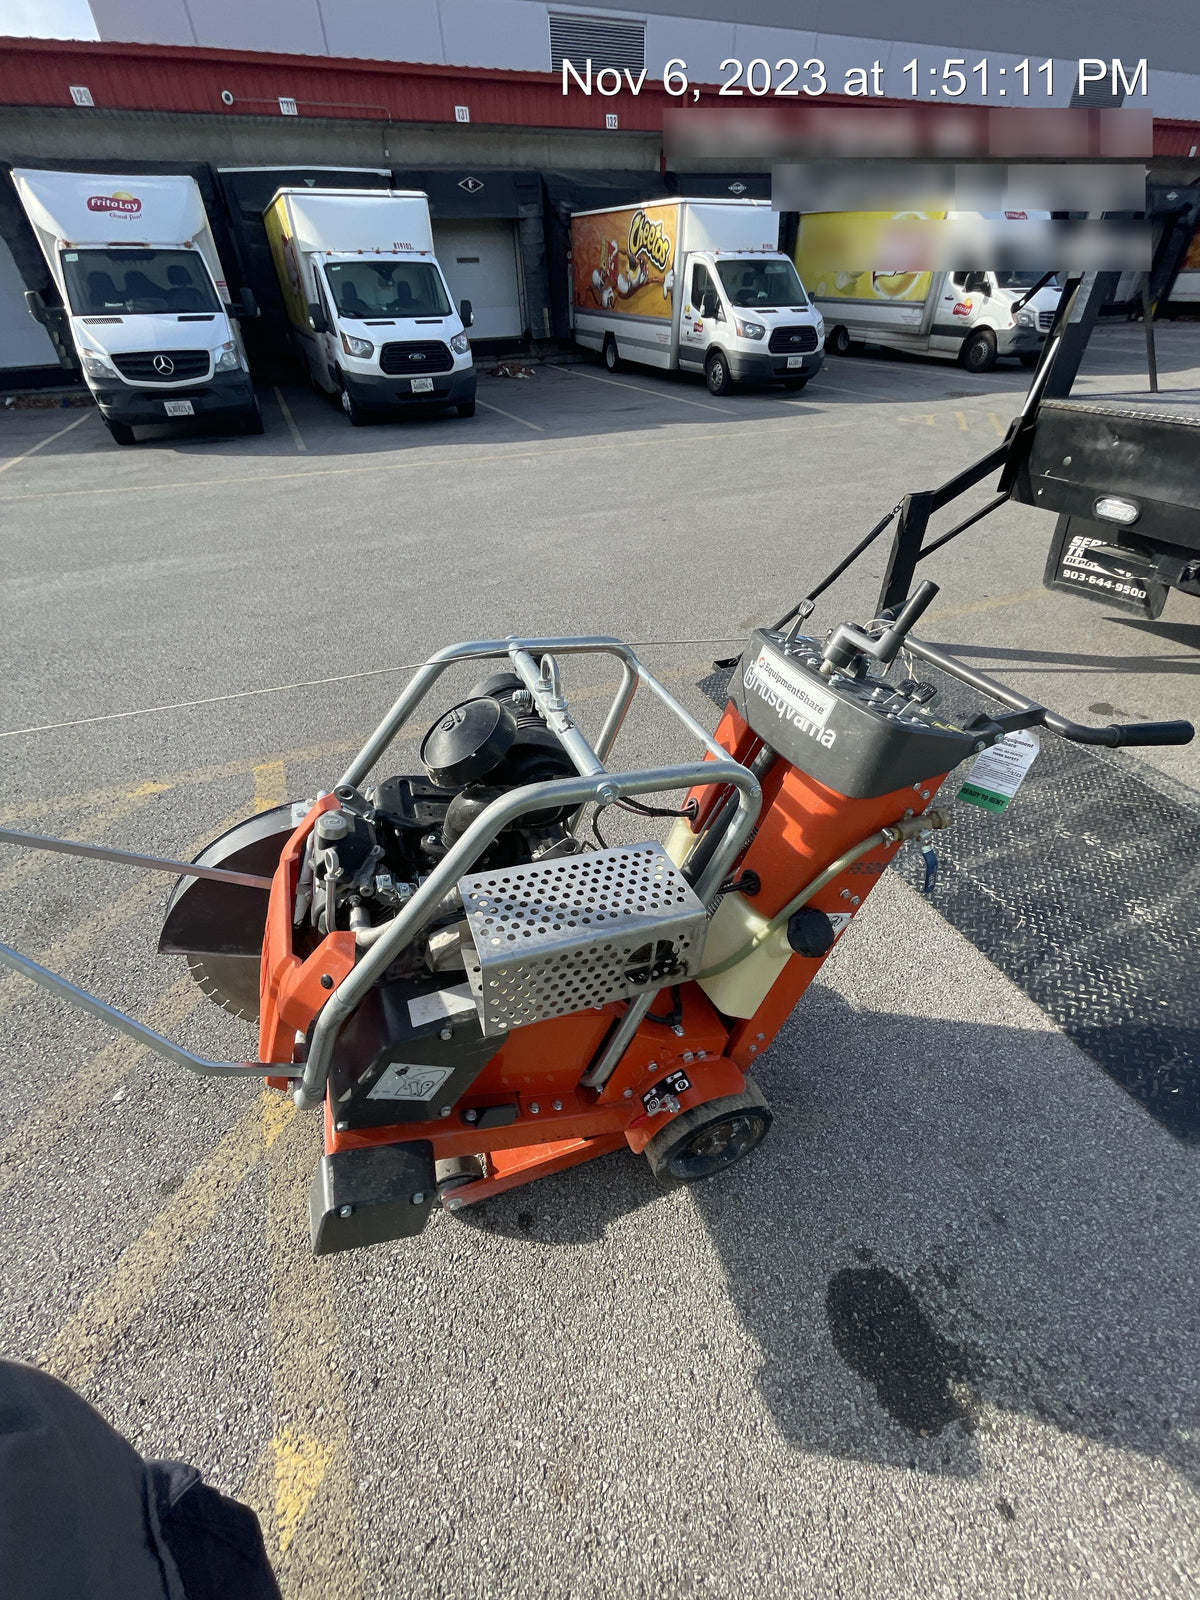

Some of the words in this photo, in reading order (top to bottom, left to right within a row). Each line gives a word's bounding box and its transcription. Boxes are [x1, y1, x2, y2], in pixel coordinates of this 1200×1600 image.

[456, 108, 468, 121] 131
[606, 116, 617, 128] 132
[629, 212, 670, 267] Cheetos
[763, 662, 825, 715] EquipmentShare
[988, 797, 1005, 807] RENT
